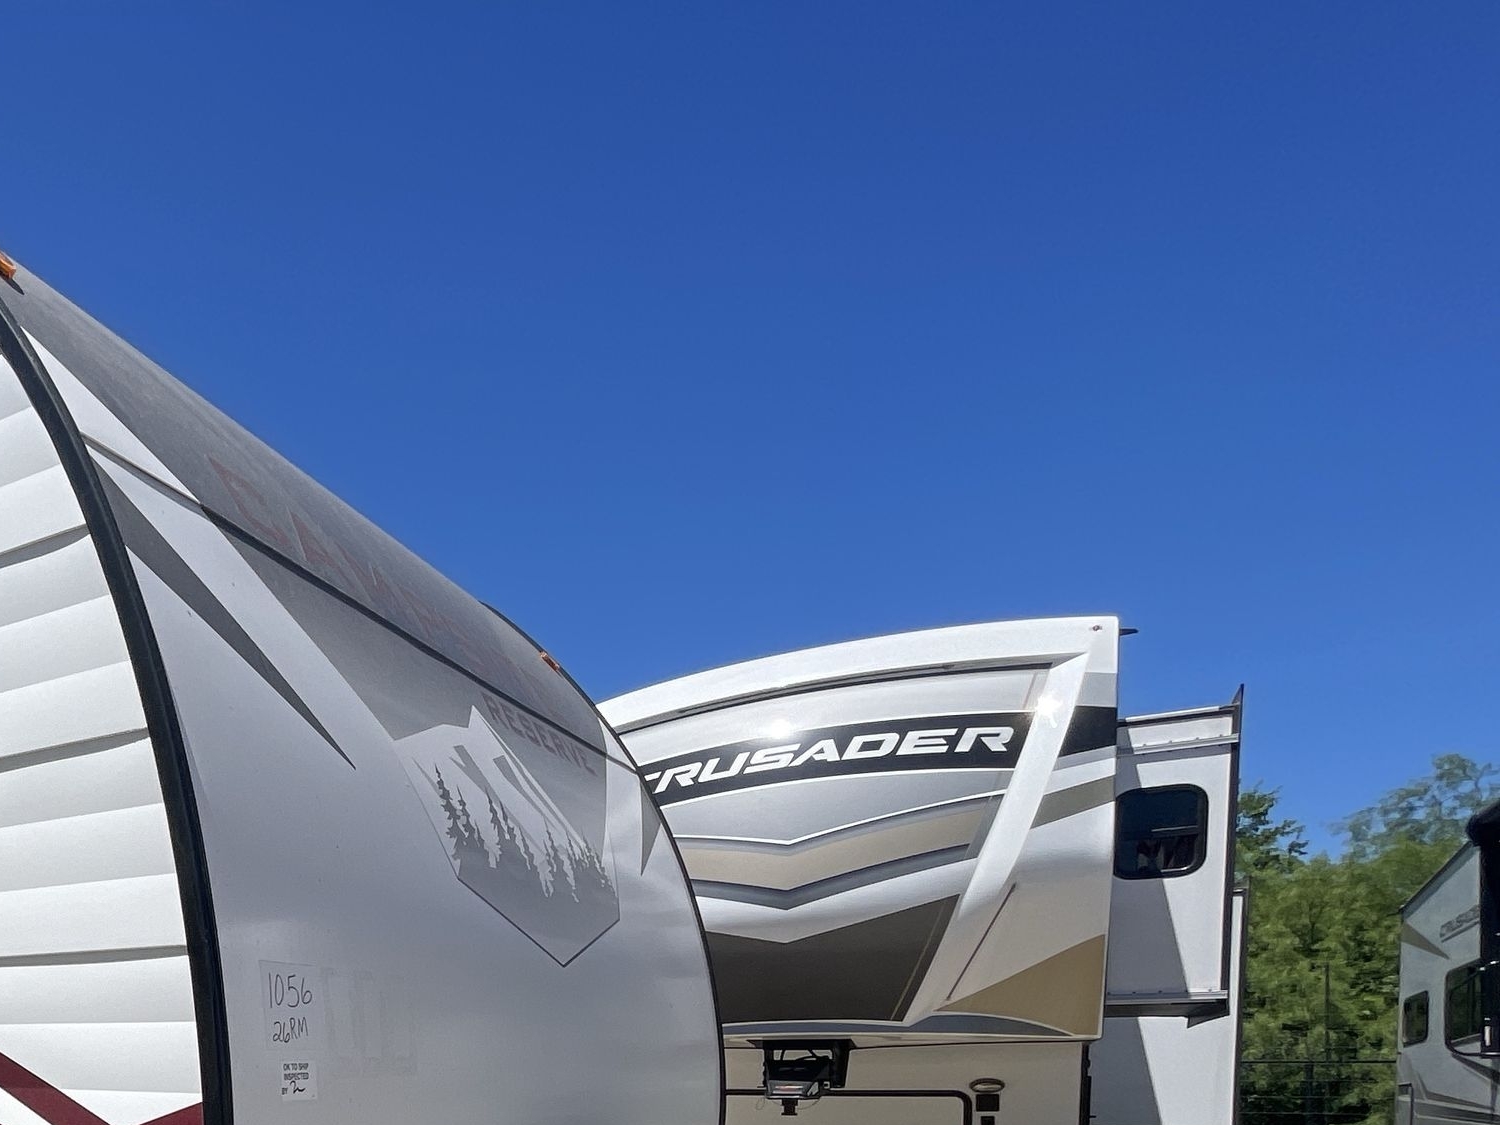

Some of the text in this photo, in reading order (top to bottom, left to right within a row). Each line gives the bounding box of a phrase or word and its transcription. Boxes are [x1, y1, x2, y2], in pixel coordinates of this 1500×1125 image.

[481, 692, 598, 777] RESERVE
[645, 726, 1015, 795] RUSADER
[268, 972, 313, 1009] 1056
